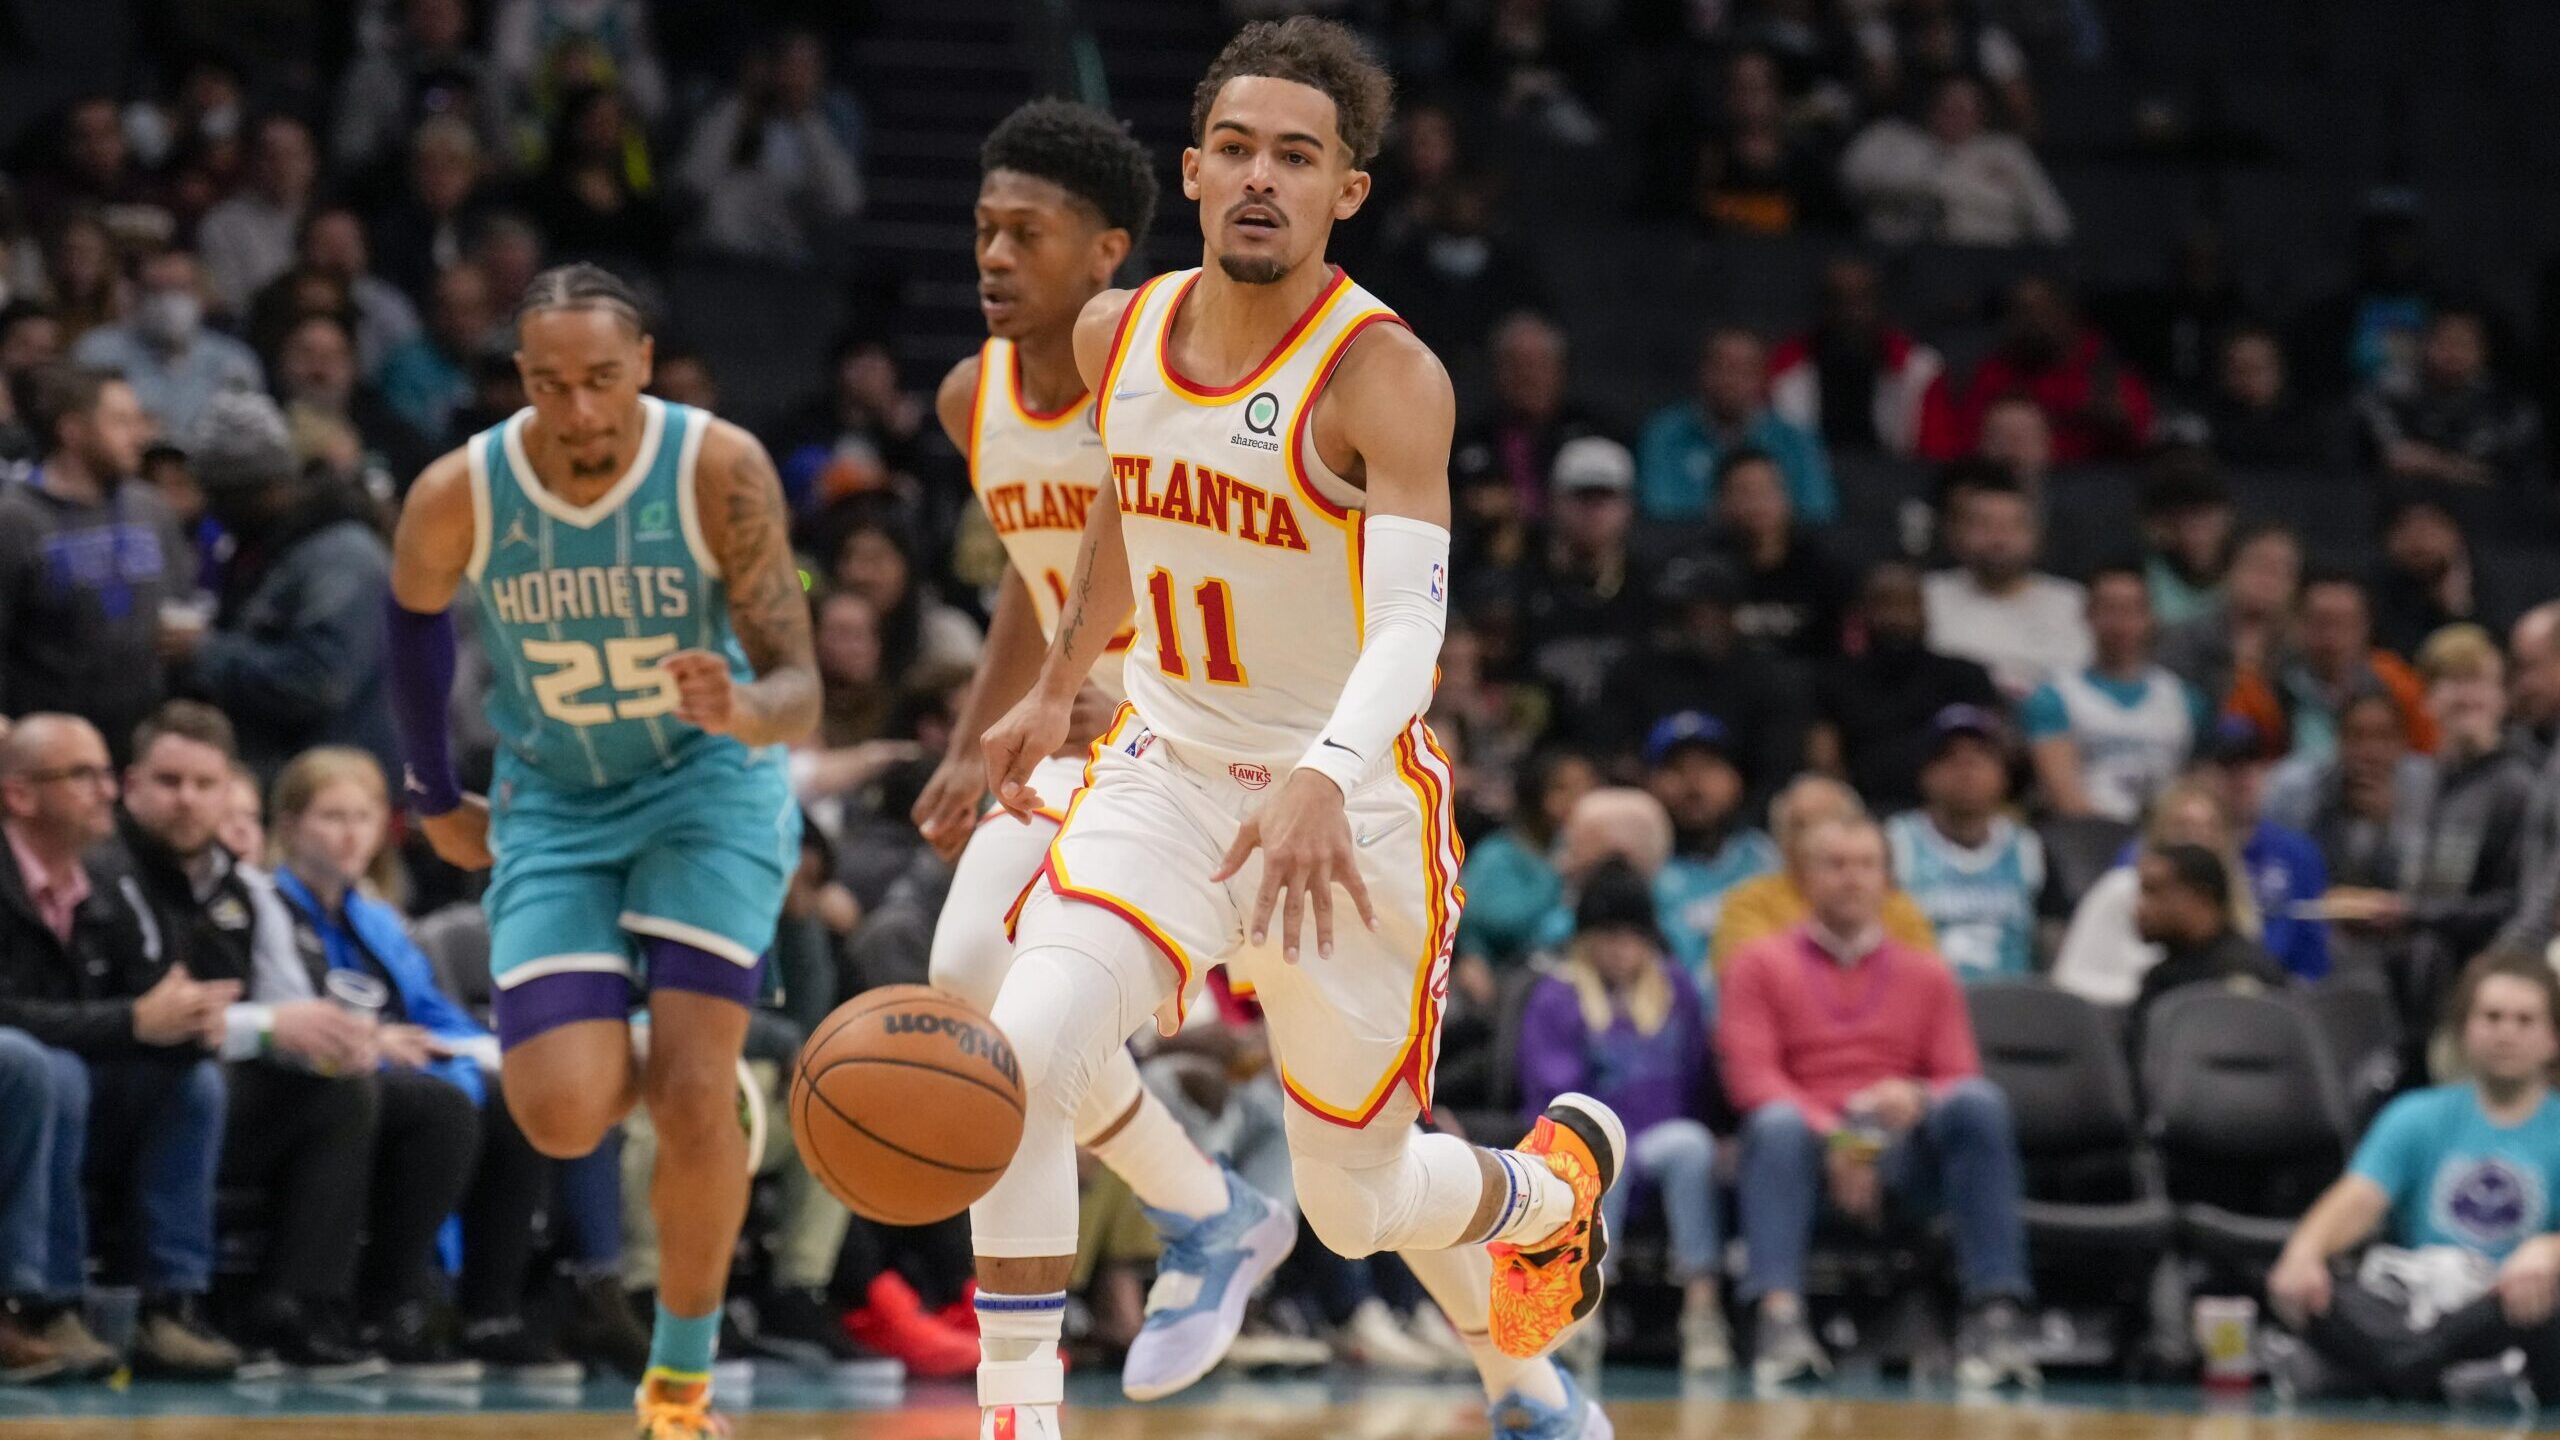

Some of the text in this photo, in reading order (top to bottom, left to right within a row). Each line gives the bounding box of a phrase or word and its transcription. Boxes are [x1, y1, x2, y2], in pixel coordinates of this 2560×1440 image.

[1230, 433, 1279, 452] sharecare
[985, 482, 1099, 534] ATLAN
[1111, 454, 1311, 554] TLANTA
[492, 566, 689, 624] HORNETS
[1147, 565, 1249, 688] 11
[522, 633, 681, 727] 25
[1228, 765, 1272, 783] HAWKS
